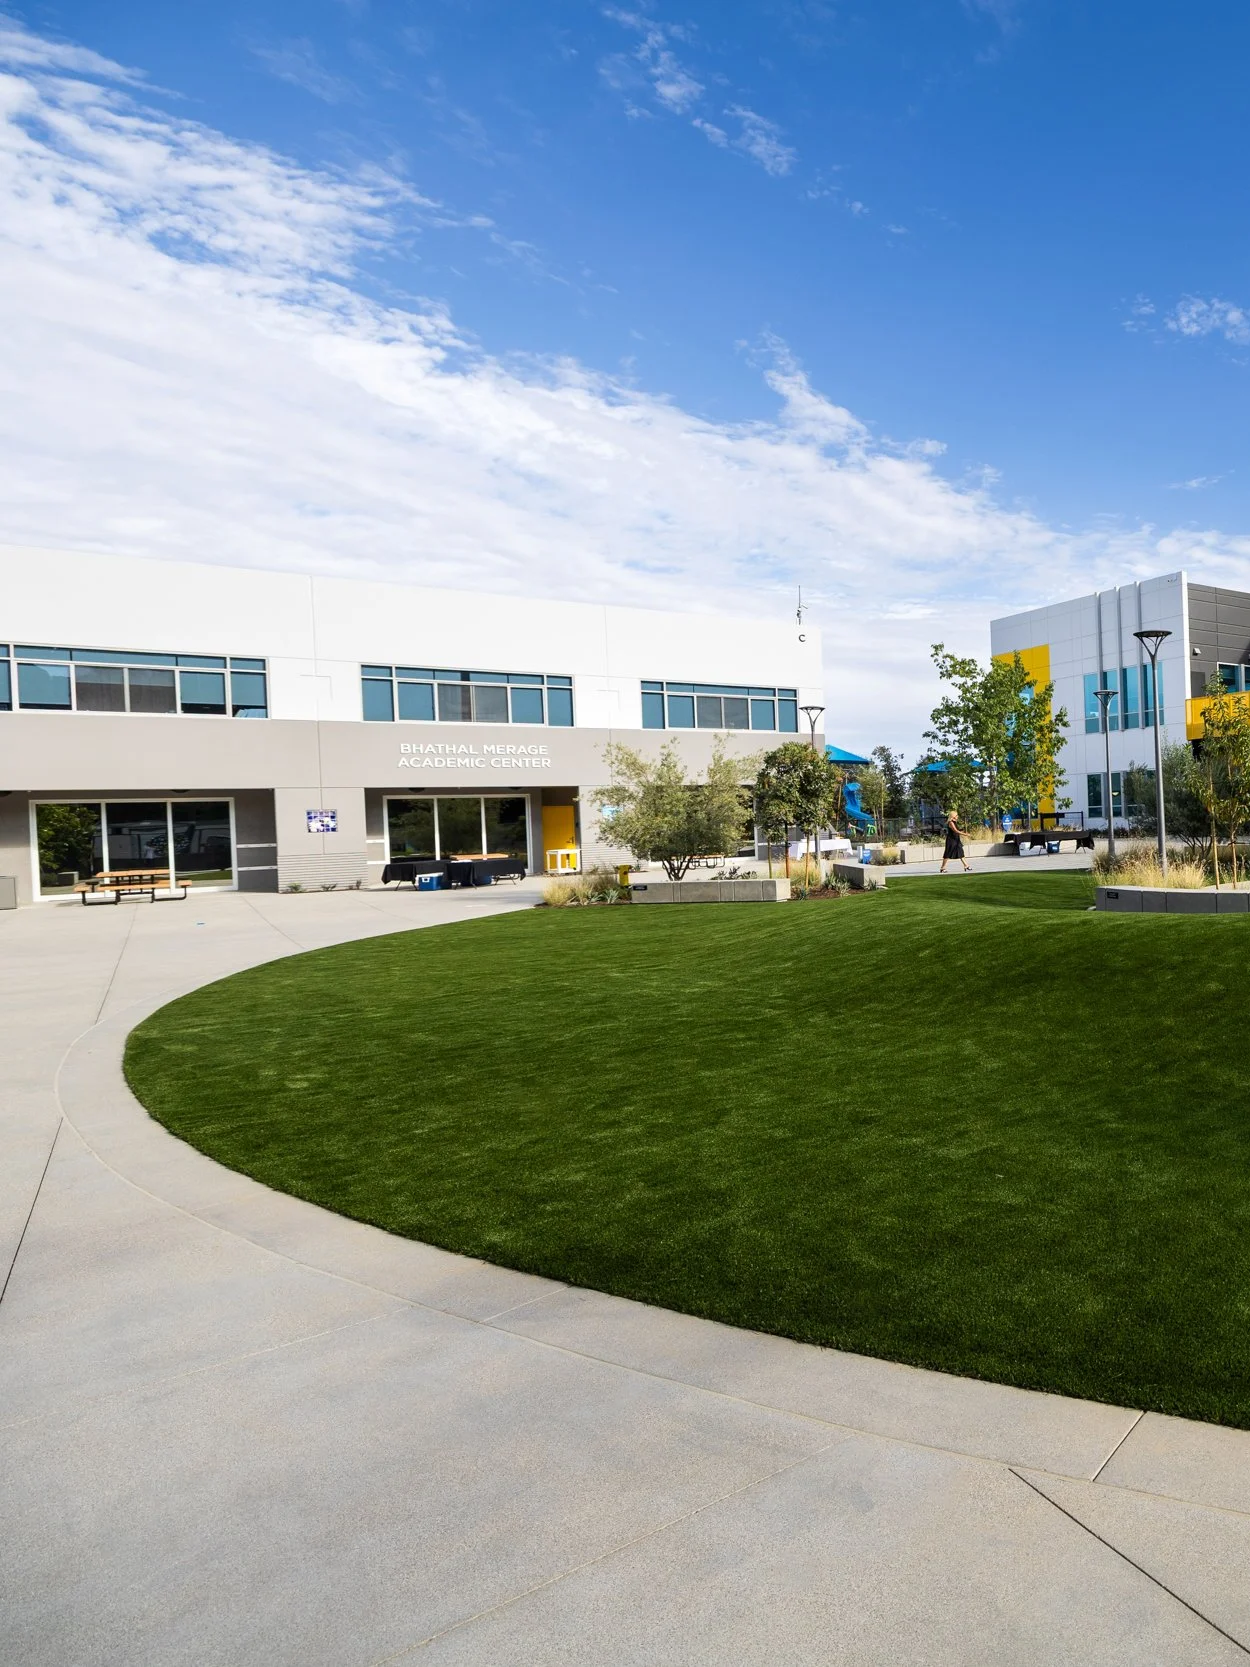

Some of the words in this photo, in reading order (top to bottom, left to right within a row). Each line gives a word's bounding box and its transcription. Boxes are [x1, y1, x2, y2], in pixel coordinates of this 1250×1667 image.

[798, 634, 806, 642] C
[400, 743, 479, 755] BHATHAL
[483, 744, 549, 755] MERAGE
[397, 757, 486, 768] ACADEMIC
[490, 757, 552, 768] CENTER
